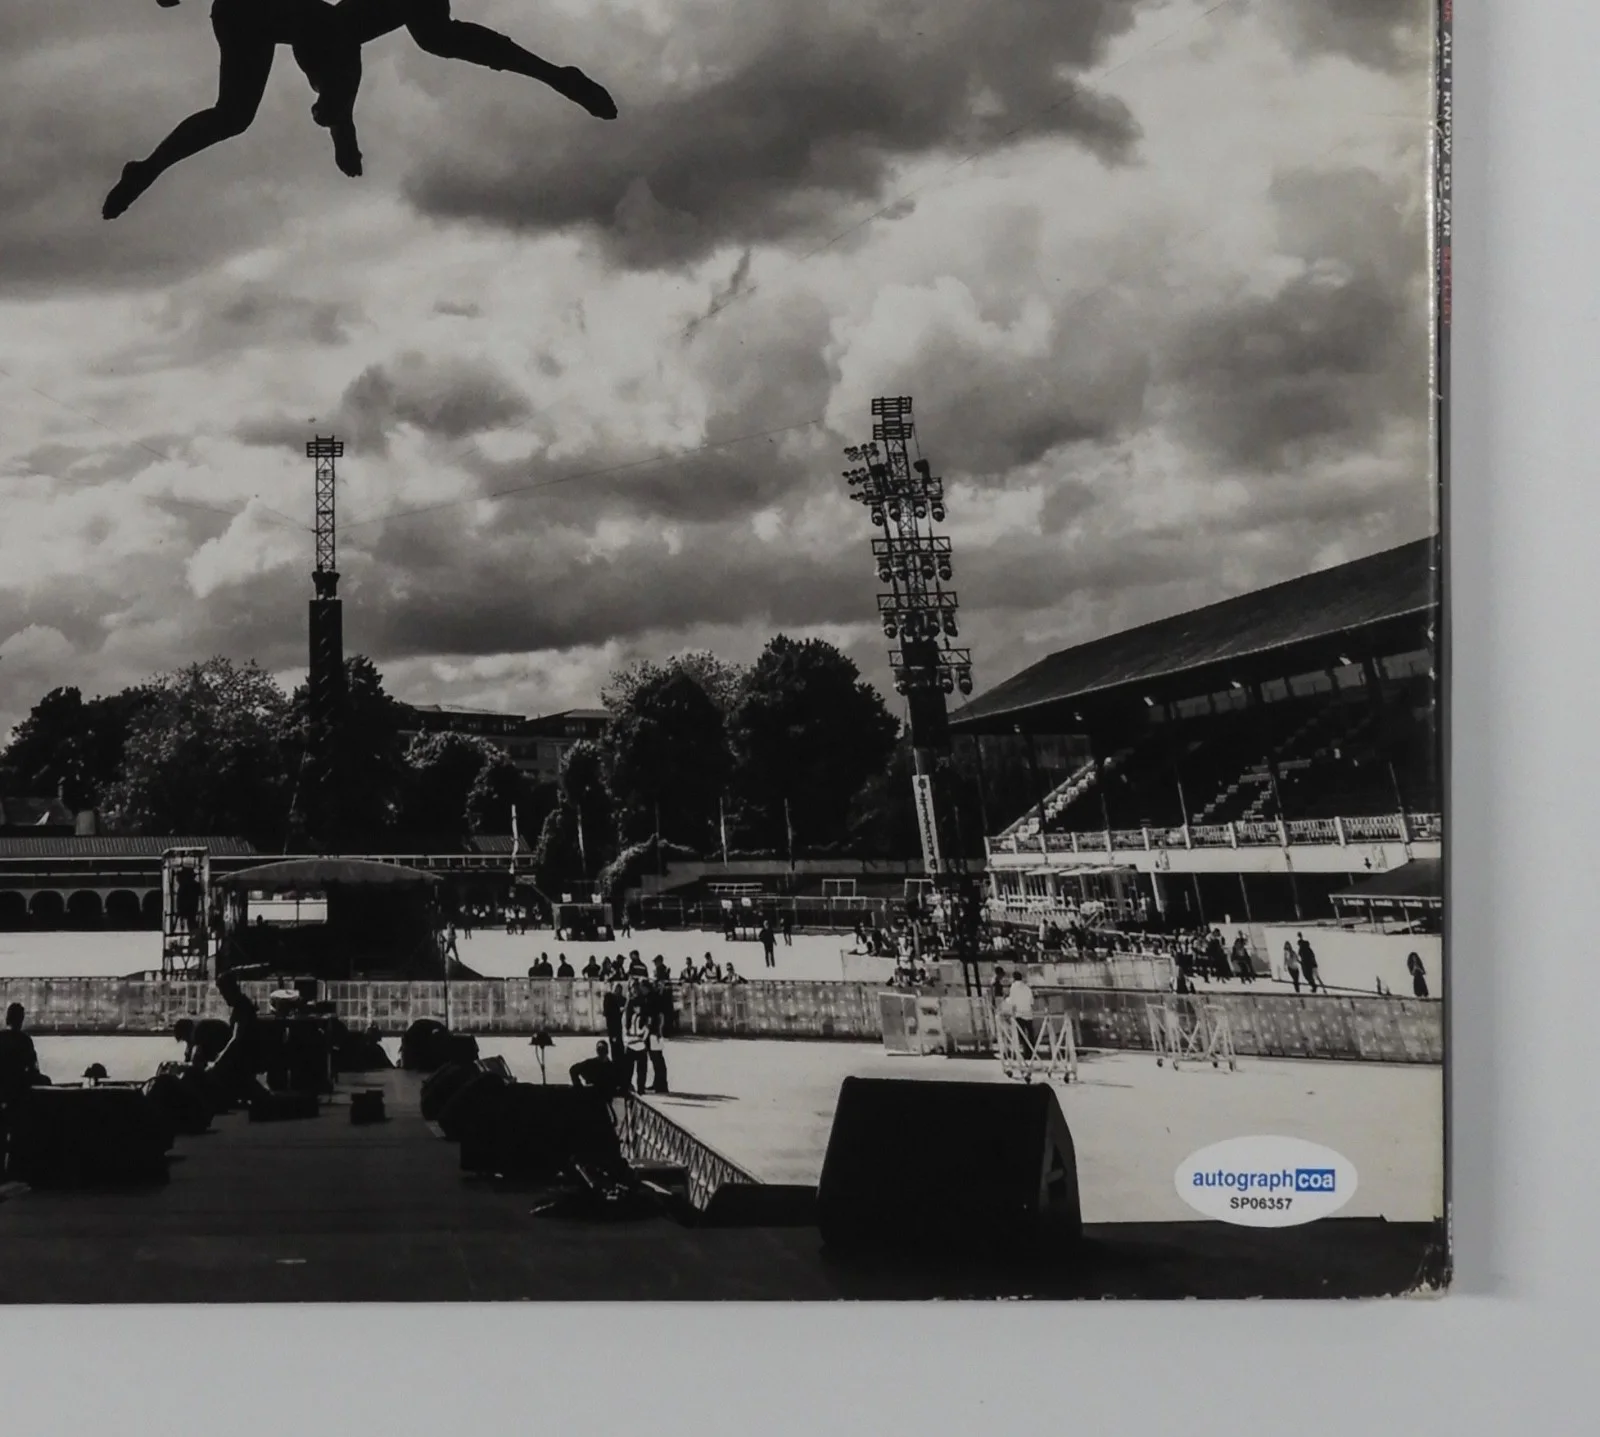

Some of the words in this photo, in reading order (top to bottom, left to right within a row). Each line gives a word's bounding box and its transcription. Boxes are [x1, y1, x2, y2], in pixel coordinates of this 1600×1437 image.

[1443, 31, 1452, 69] ALL
[1443, 91, 1452, 155] KNOW
[1443, 163, 1452, 190] SO
[1443, 198, 1452, 237] FAR
[1230, 1197, 1293, 1210] SP06357
